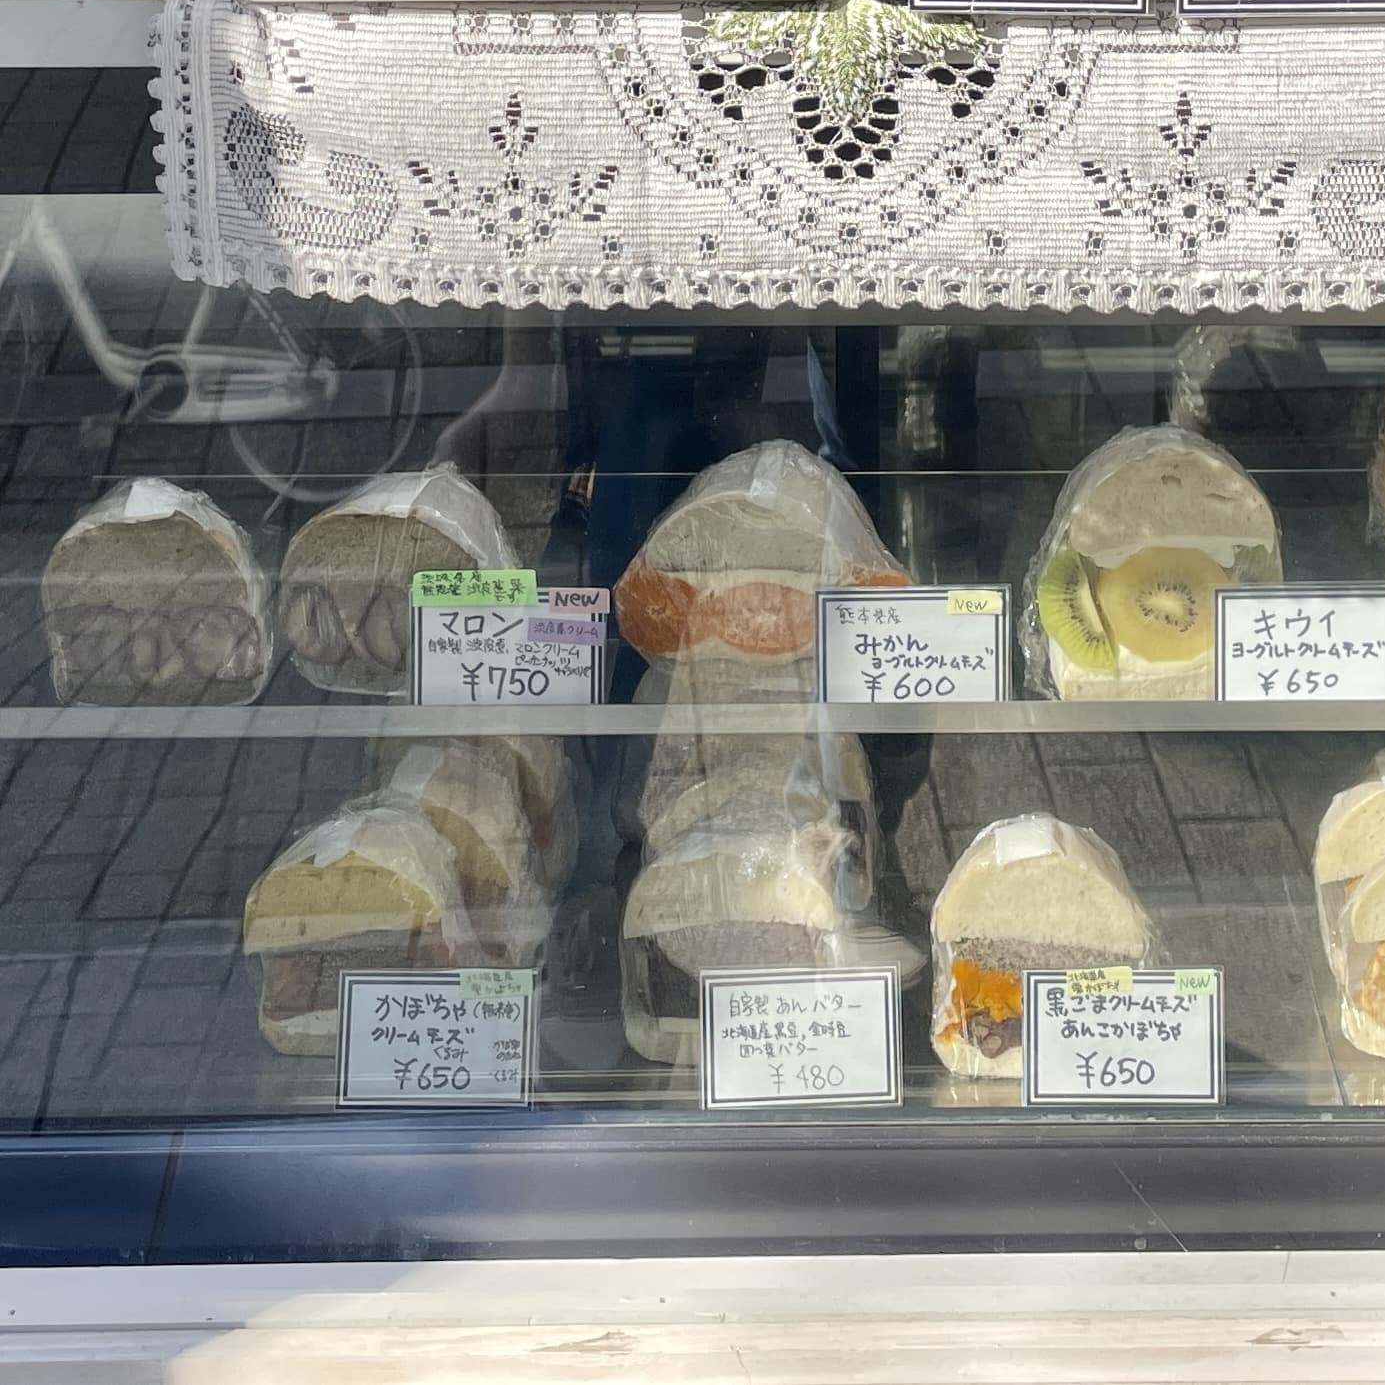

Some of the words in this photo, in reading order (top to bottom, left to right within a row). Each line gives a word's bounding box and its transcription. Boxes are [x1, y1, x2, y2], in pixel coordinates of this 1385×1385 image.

[953, 598, 988, 613] New
[439, 611, 524, 637] マロン
[1253, 608, 1336, 640] キウイ
[854, 634, 929, 656] みかん
[461, 662, 550, 702] ¥750
[861, 670, 956, 703] ¥600
[1257, 668, 1339, 696] ¥650
[1061, 1019, 1182, 1042] あんこかぼちゃ
[393, 1058, 471, 1090] ¥650
[768, 1064, 845, 1094] ¥480
[1075, 1051, 1156, 1089] ¥650
